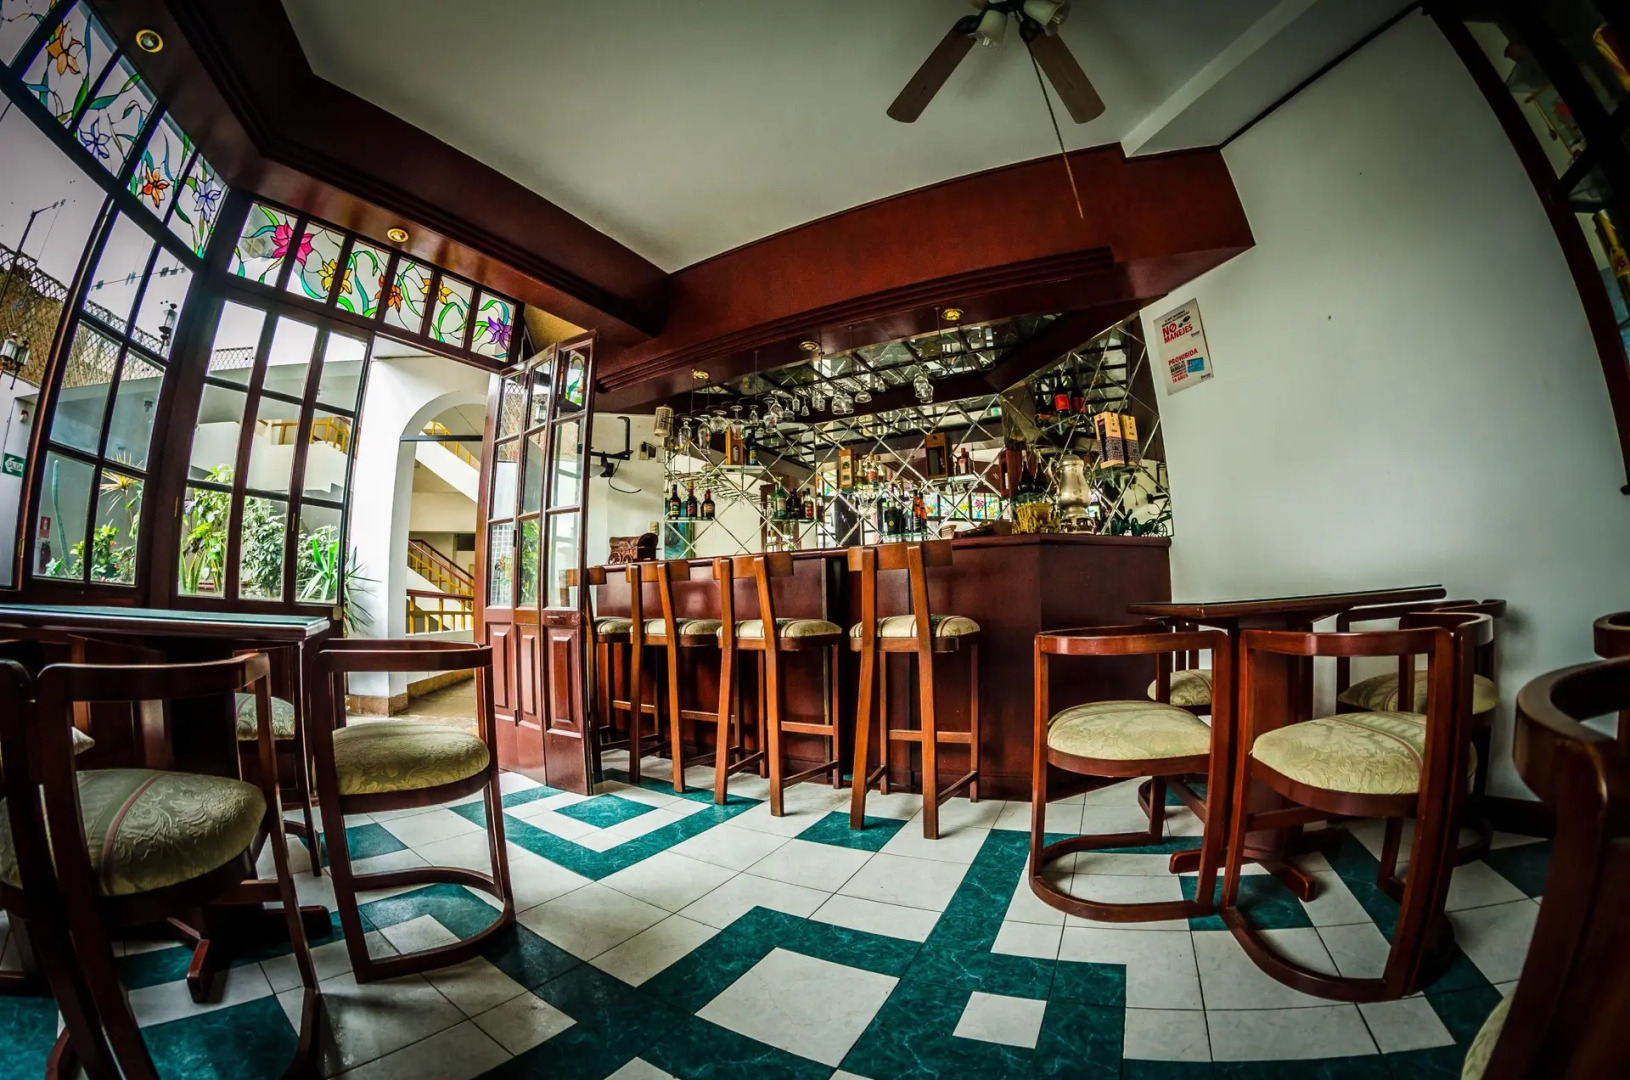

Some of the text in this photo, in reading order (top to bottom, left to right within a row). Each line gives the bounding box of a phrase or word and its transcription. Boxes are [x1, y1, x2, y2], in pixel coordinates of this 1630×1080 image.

[1162, 323, 1177, 337] NO
[1163, 324, 1193, 344] MANEJES
[1168, 348, 1198, 366] PROHIBIDA
